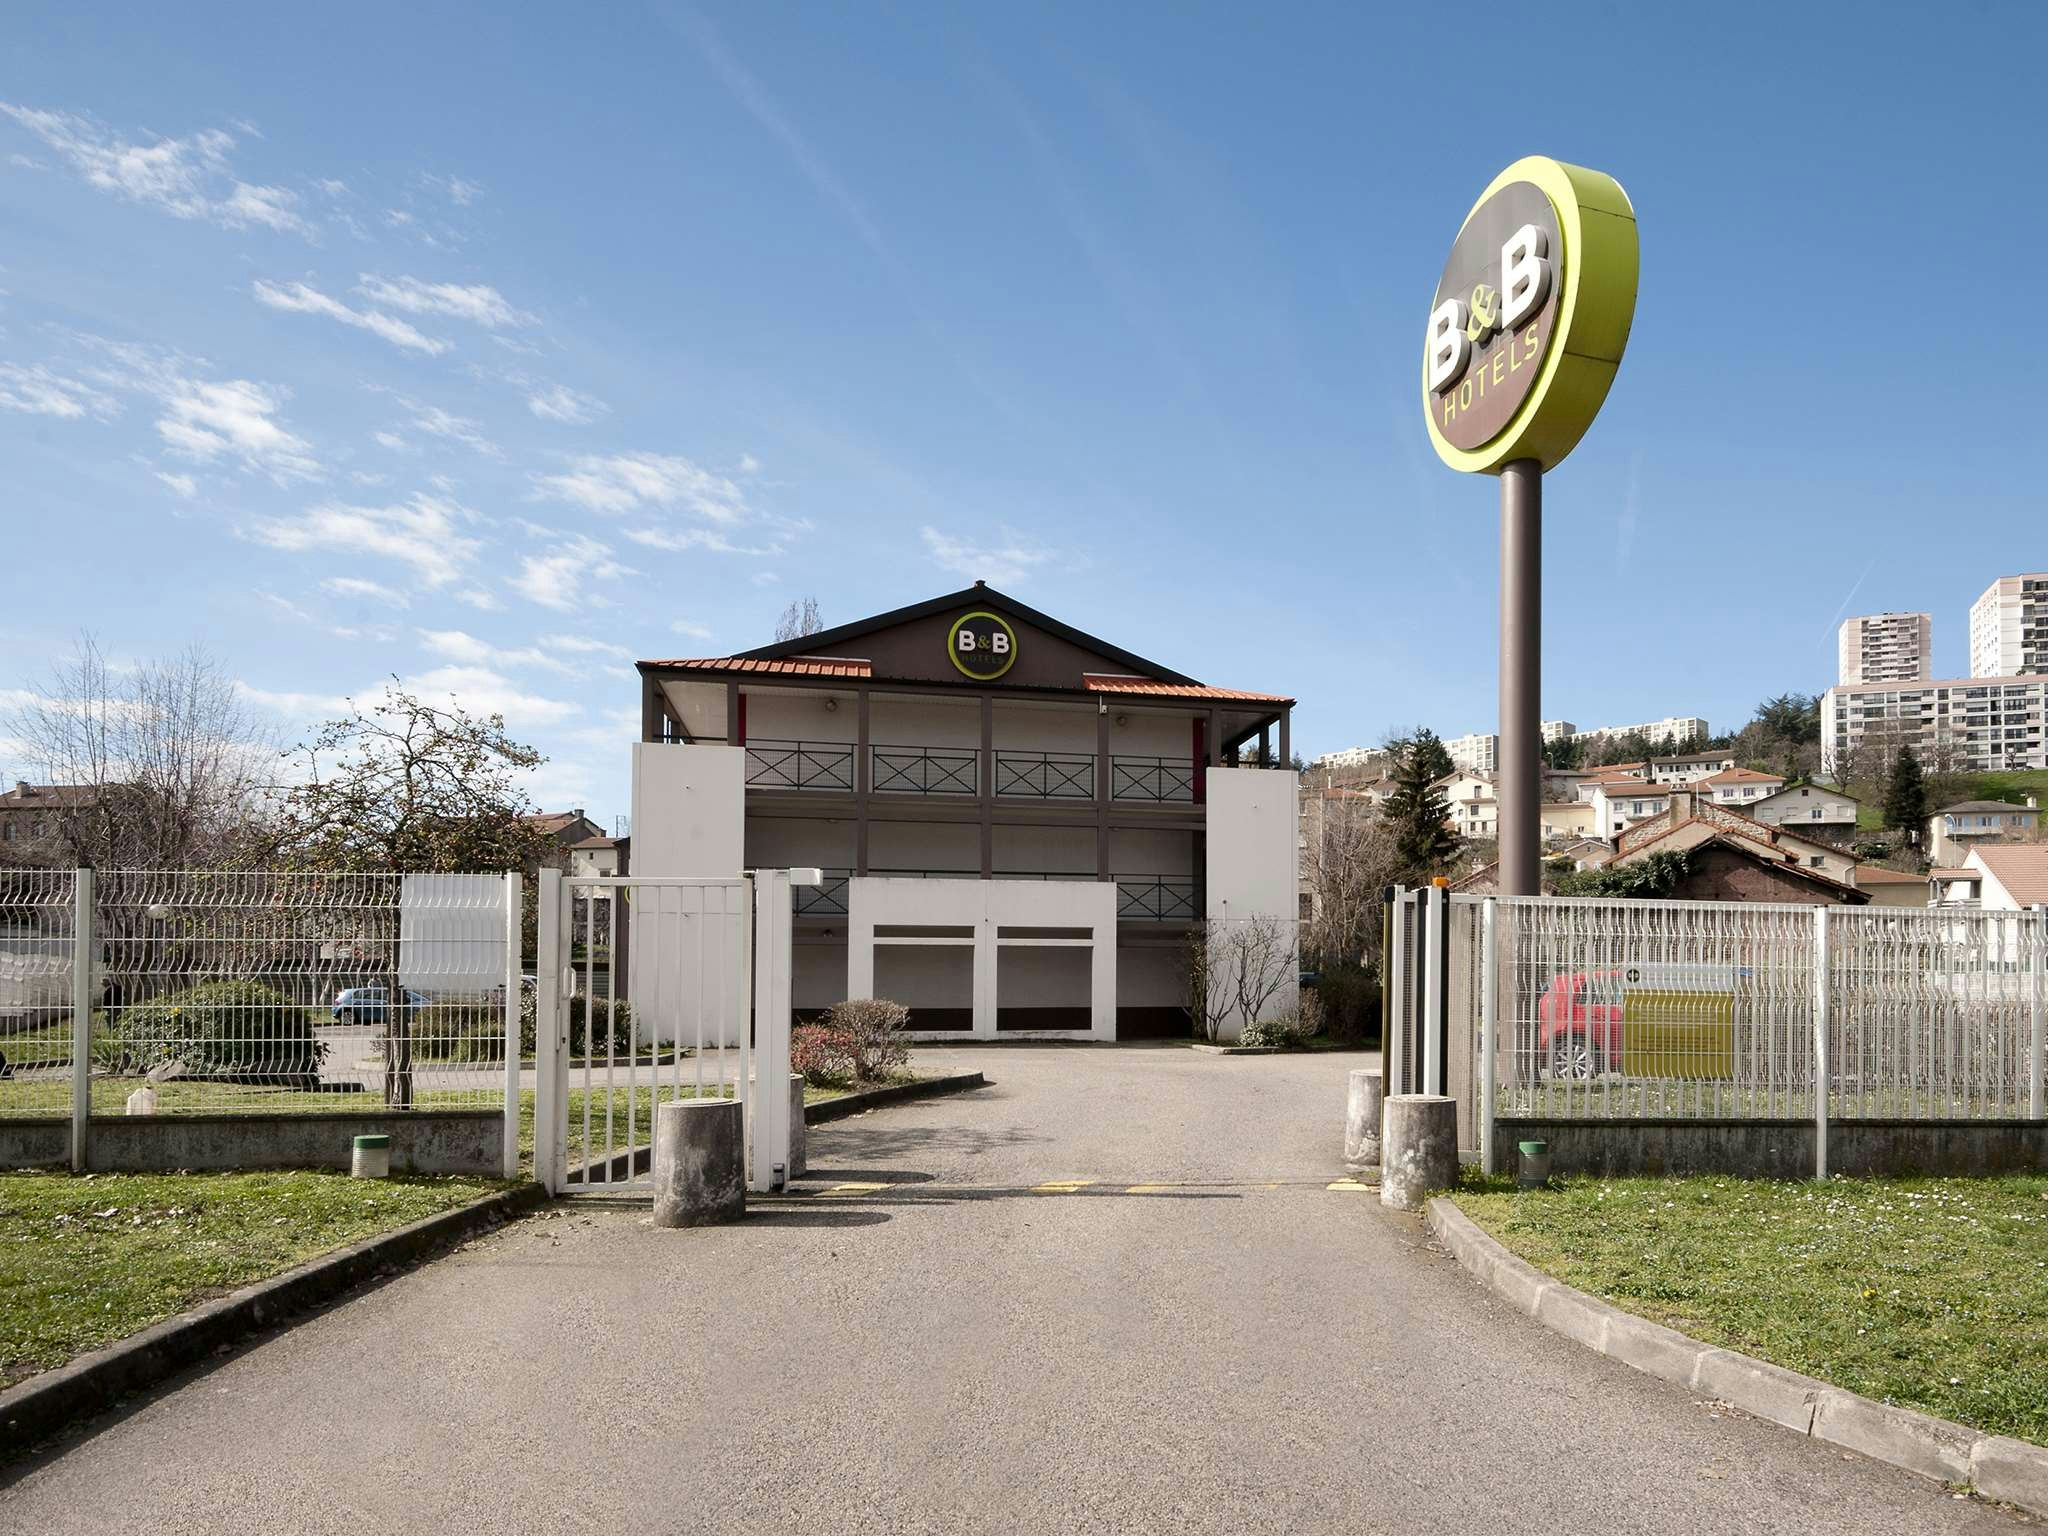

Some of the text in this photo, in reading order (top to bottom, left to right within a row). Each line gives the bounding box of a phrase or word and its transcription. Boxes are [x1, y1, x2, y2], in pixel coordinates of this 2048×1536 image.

[1429, 224, 1549, 394] B&B
[1444, 323, 1538, 426] HOTELS
[959, 630, 1009, 653] B&B
